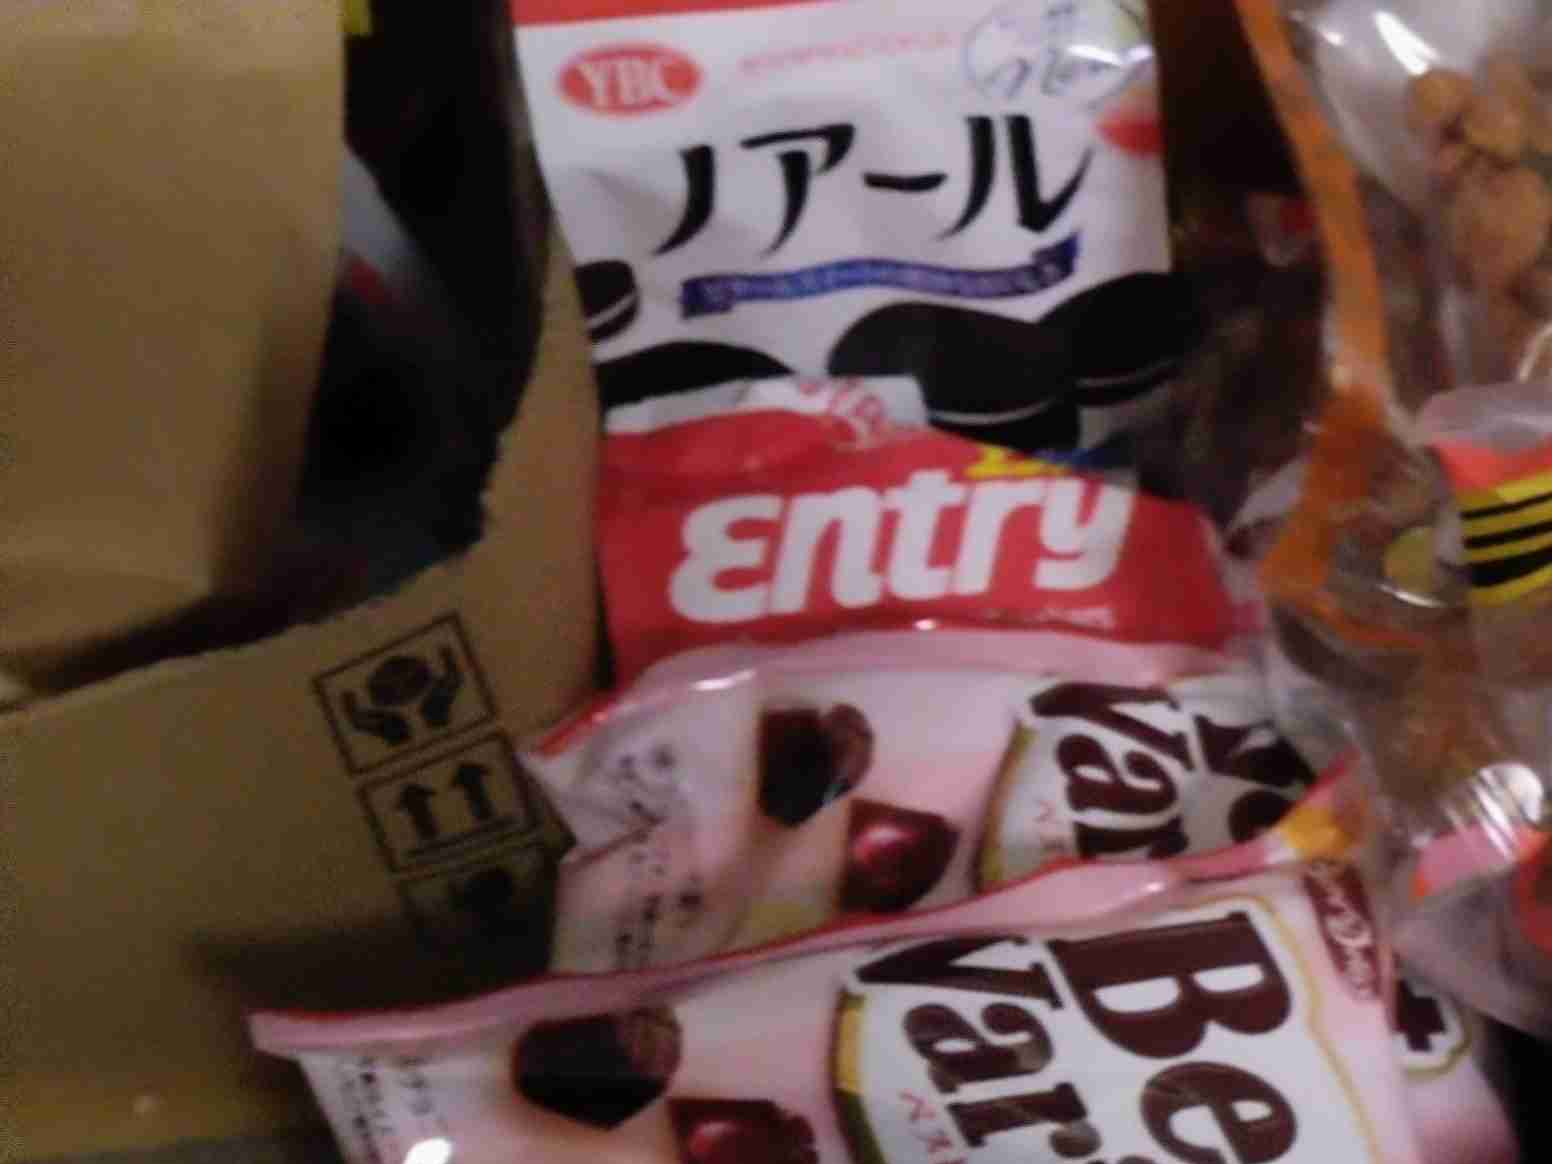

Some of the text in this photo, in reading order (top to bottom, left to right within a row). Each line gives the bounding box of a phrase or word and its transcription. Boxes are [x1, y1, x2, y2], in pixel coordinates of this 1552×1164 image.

[581, 56, 680, 106] YBC
[652, 114, 1096, 257] ノアール
